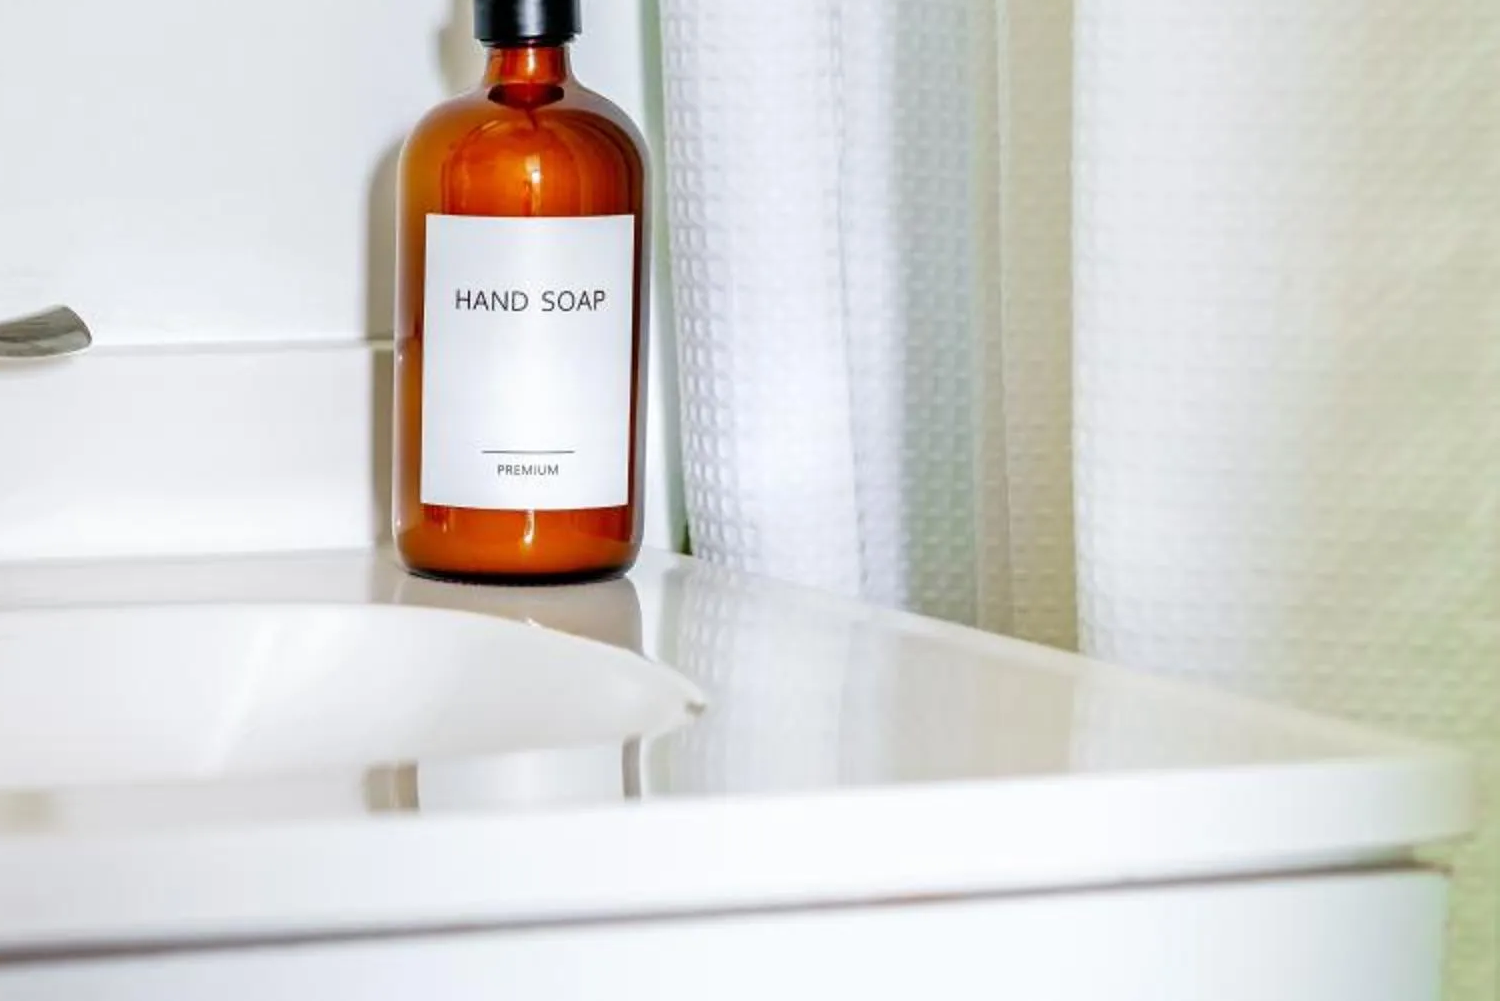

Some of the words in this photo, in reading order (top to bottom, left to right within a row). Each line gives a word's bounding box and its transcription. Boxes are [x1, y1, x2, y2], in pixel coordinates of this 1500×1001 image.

[455, 289, 529, 312] HAND
[541, 289, 606, 312] SOAP
[497, 464, 559, 476] PREMIUM
